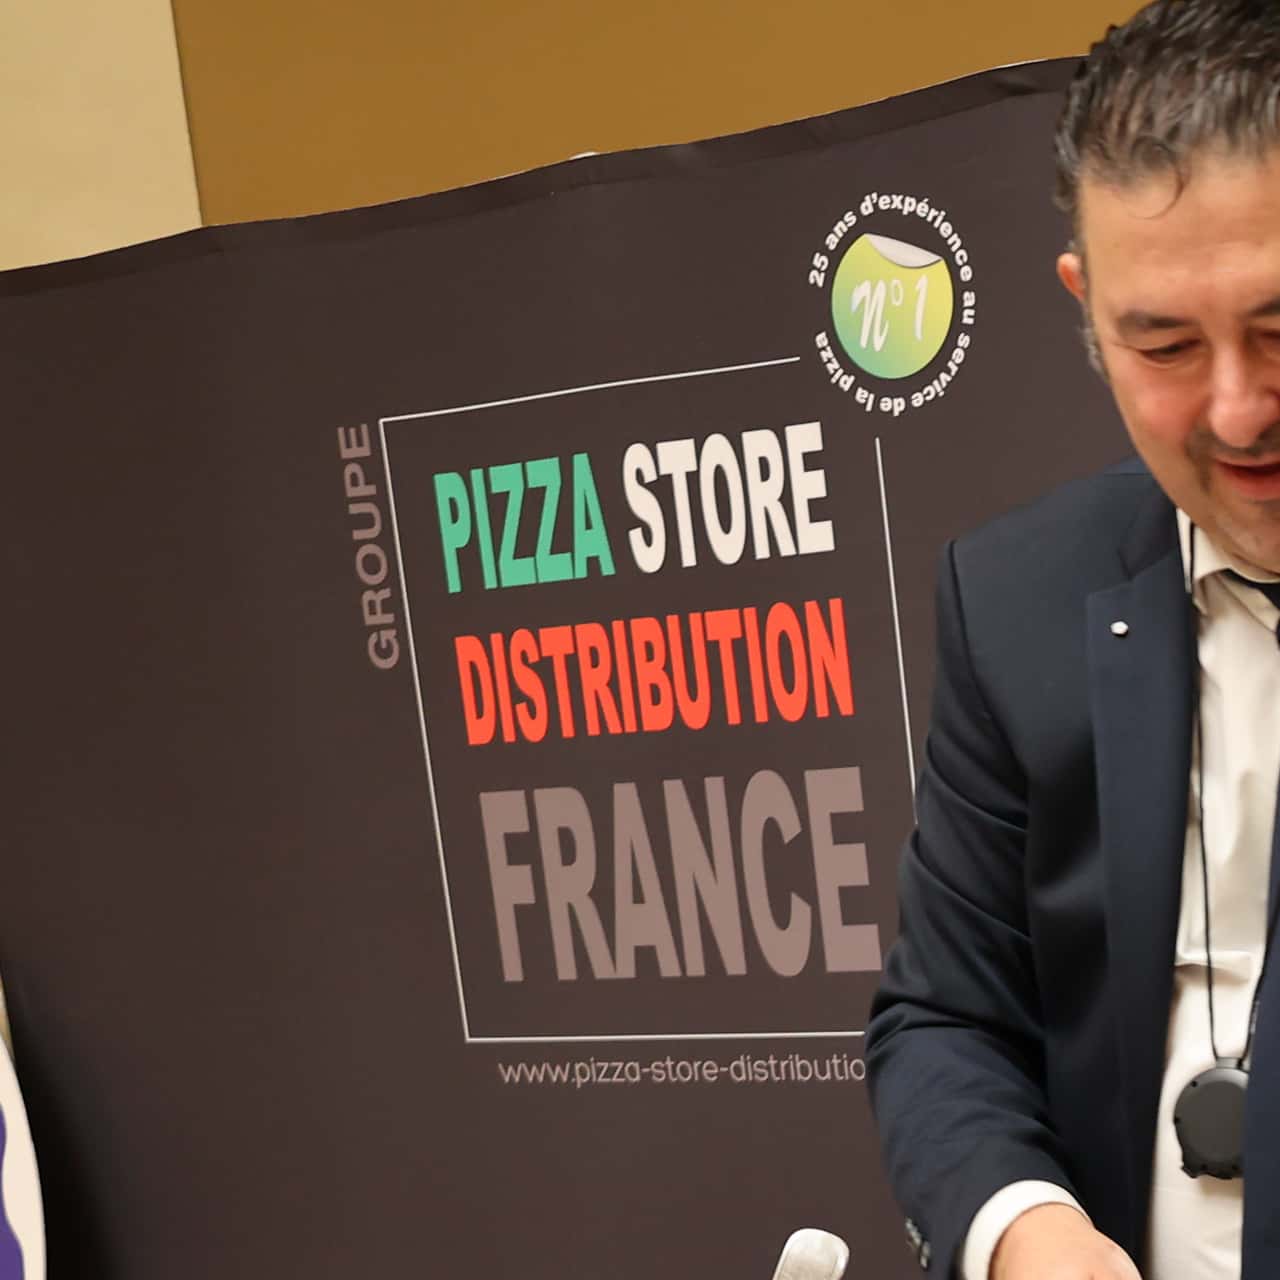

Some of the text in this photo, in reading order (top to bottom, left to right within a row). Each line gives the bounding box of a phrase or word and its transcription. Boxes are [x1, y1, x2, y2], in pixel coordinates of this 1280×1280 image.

[825, 210, 857, 250] ans
[808, 252, 829, 288] 25
[961, 291, 976, 325] au
[815, 331, 855, 392] pizza
[911, 332, 971, 408] service
[855, 386, 875, 412] la
[879, 396, 906, 416] de
[433, 421, 835, 594] PIZZA STORE
[337, 422, 400, 670] GROUPE
[454, 598, 856, 746] DISTRIBUTION
[479, 766, 883, 983] FRANCE
